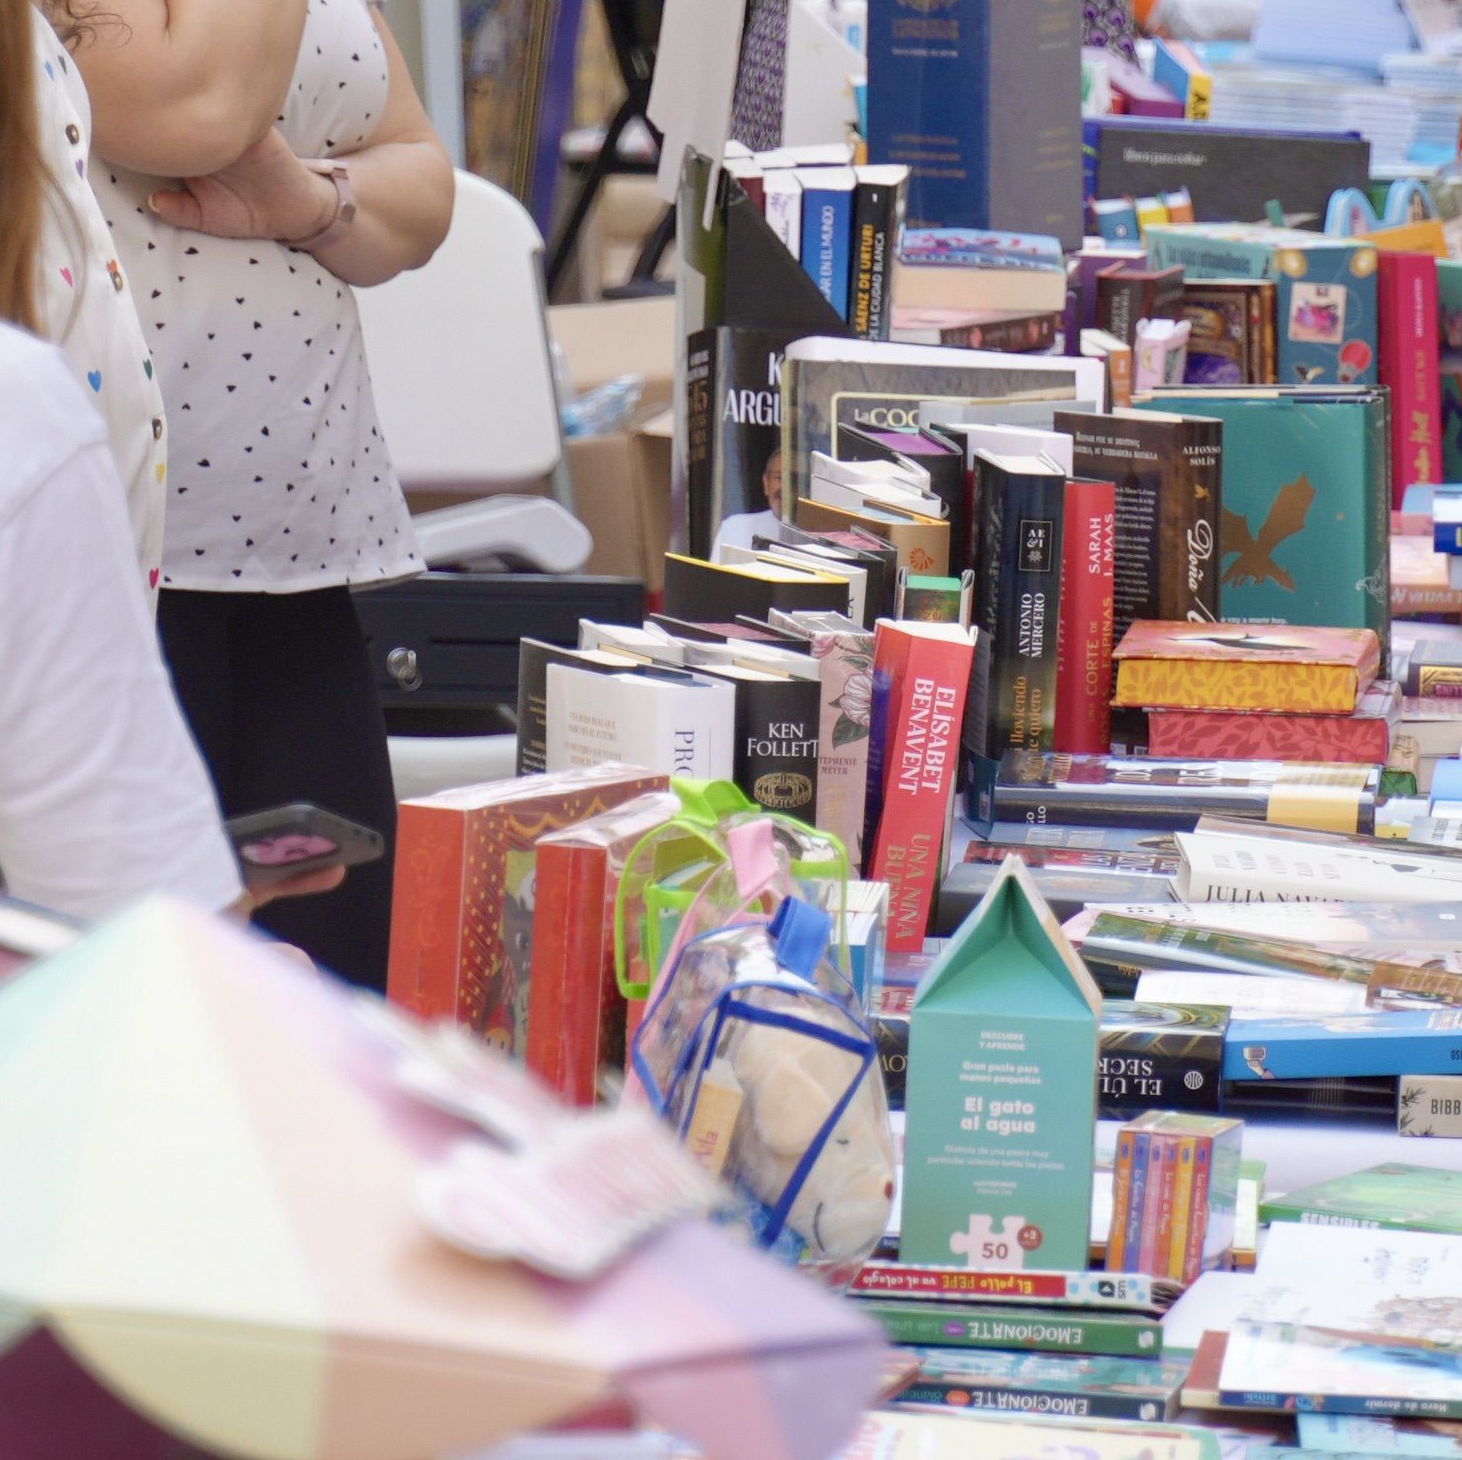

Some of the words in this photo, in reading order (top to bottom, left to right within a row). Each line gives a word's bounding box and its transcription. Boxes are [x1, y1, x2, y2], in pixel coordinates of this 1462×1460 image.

[873, 232, 885, 272] BLANCA
[858, 273, 871, 289] DE
[871, 274, 883, 312] CIUDAD
[1182, 445, 1221, 456] ALFONSO
[1189, 456, 1216, 466] SOLÍS
[1089, 517, 1101, 574] SARAH
[1103, 513, 1114, 561] MAAS
[1187, 519, 1214, 595] Doña
[1018, 593, 1033, 657] ANTONIO
[1031, 592, 1046, 658] MERCERO
[1101, 596, 1112, 668] ESPINAS
[1085, 639, 1098, 695] CORTE
[1010, 675, 1027, 743] lloviendo
[1026, 688, 1043, 736] quiero
[768, 722, 804, 739] KEN
[898, 677, 935, 796] BENAVENT
[921, 685, 956, 794] ELÍSABET
[746, 738, 820, 758] FOLLETT
[818, 756, 858, 767] TEPHENIE
[905, 833, 932, 879] UNA
[1205, 884, 1266, 903] JULIA
[894, 886, 924, 939] NIÑA
[980, 1031, 1025, 1041] DESCUBRE
[985, 1041, 1026, 1052] APRENDE
[962, 1061, 986, 1072] Gran
[1017, 1065, 1040, 1076] para
[959, 1073, 992, 1084] manos
[993, 1074, 1041, 1086] pequeñas
[1134, 1078, 1162, 1096] EL
[964, 1096, 983, 1112] El
[989, 1100, 1035, 1117] gato
[960, 1115, 980, 1131] al
[986, 1119, 1035, 1136] agua
[981, 1242, 1009, 1259] 50
[908, 1274, 920, 1288] al
[922, 1275, 936, 1286] va
[942, 1274, 975, 1290] PEPE
[980, 1276, 1016, 1293] pollo
[1018, 1281, 1032, 1295] El
[1364, 1399, 1401, 1410] dormir
[1402, 1401, 1416, 1412] de
[1419, 1401, 1448, 1413] Hora
